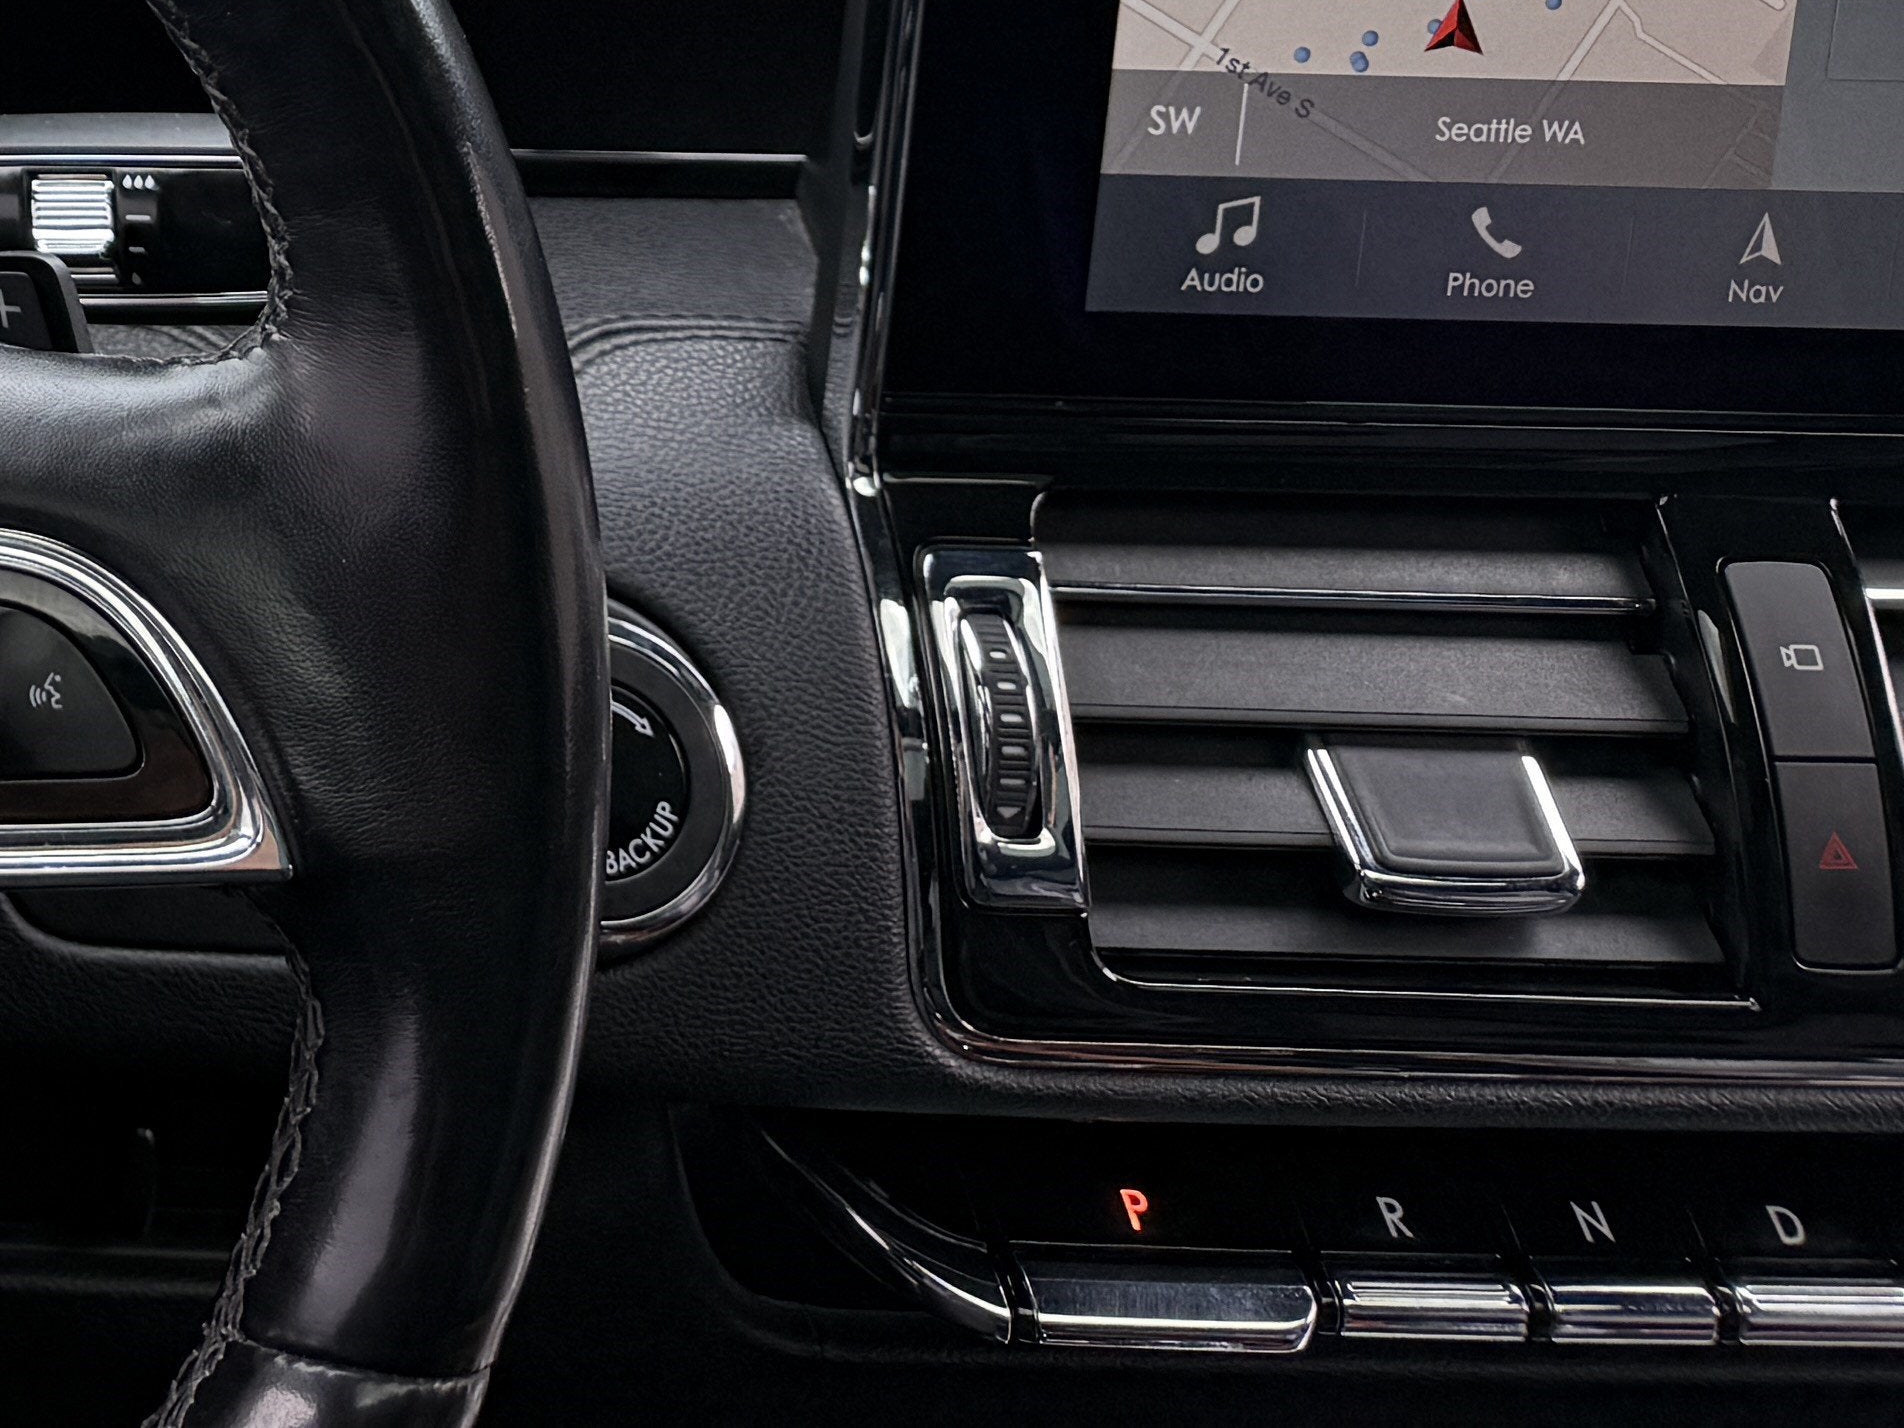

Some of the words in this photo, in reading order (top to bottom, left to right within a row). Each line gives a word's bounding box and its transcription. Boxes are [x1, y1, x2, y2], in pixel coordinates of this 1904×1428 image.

[1216, 47, 1250, 79] 1st
[1248, 71, 1291, 105] Ave
[1294, 98, 1315, 118] S
[1147, 104, 1204, 138] SW
[1435, 116, 1535, 146] Seattle
[1542, 119, 1587, 147] WA
[1180, 267, 1266, 295] Audio
[1446, 272, 1537, 301] Phone
[1728, 279, 1786, 306] Nav
[604, 800, 681, 876] BACKUP
[1119, 1188, 1151, 1233] P
[1375, 1196, 1416, 1240] R
[1570, 1200, 1617, 1245] N
[1765, 1205, 1808, 1248] D
